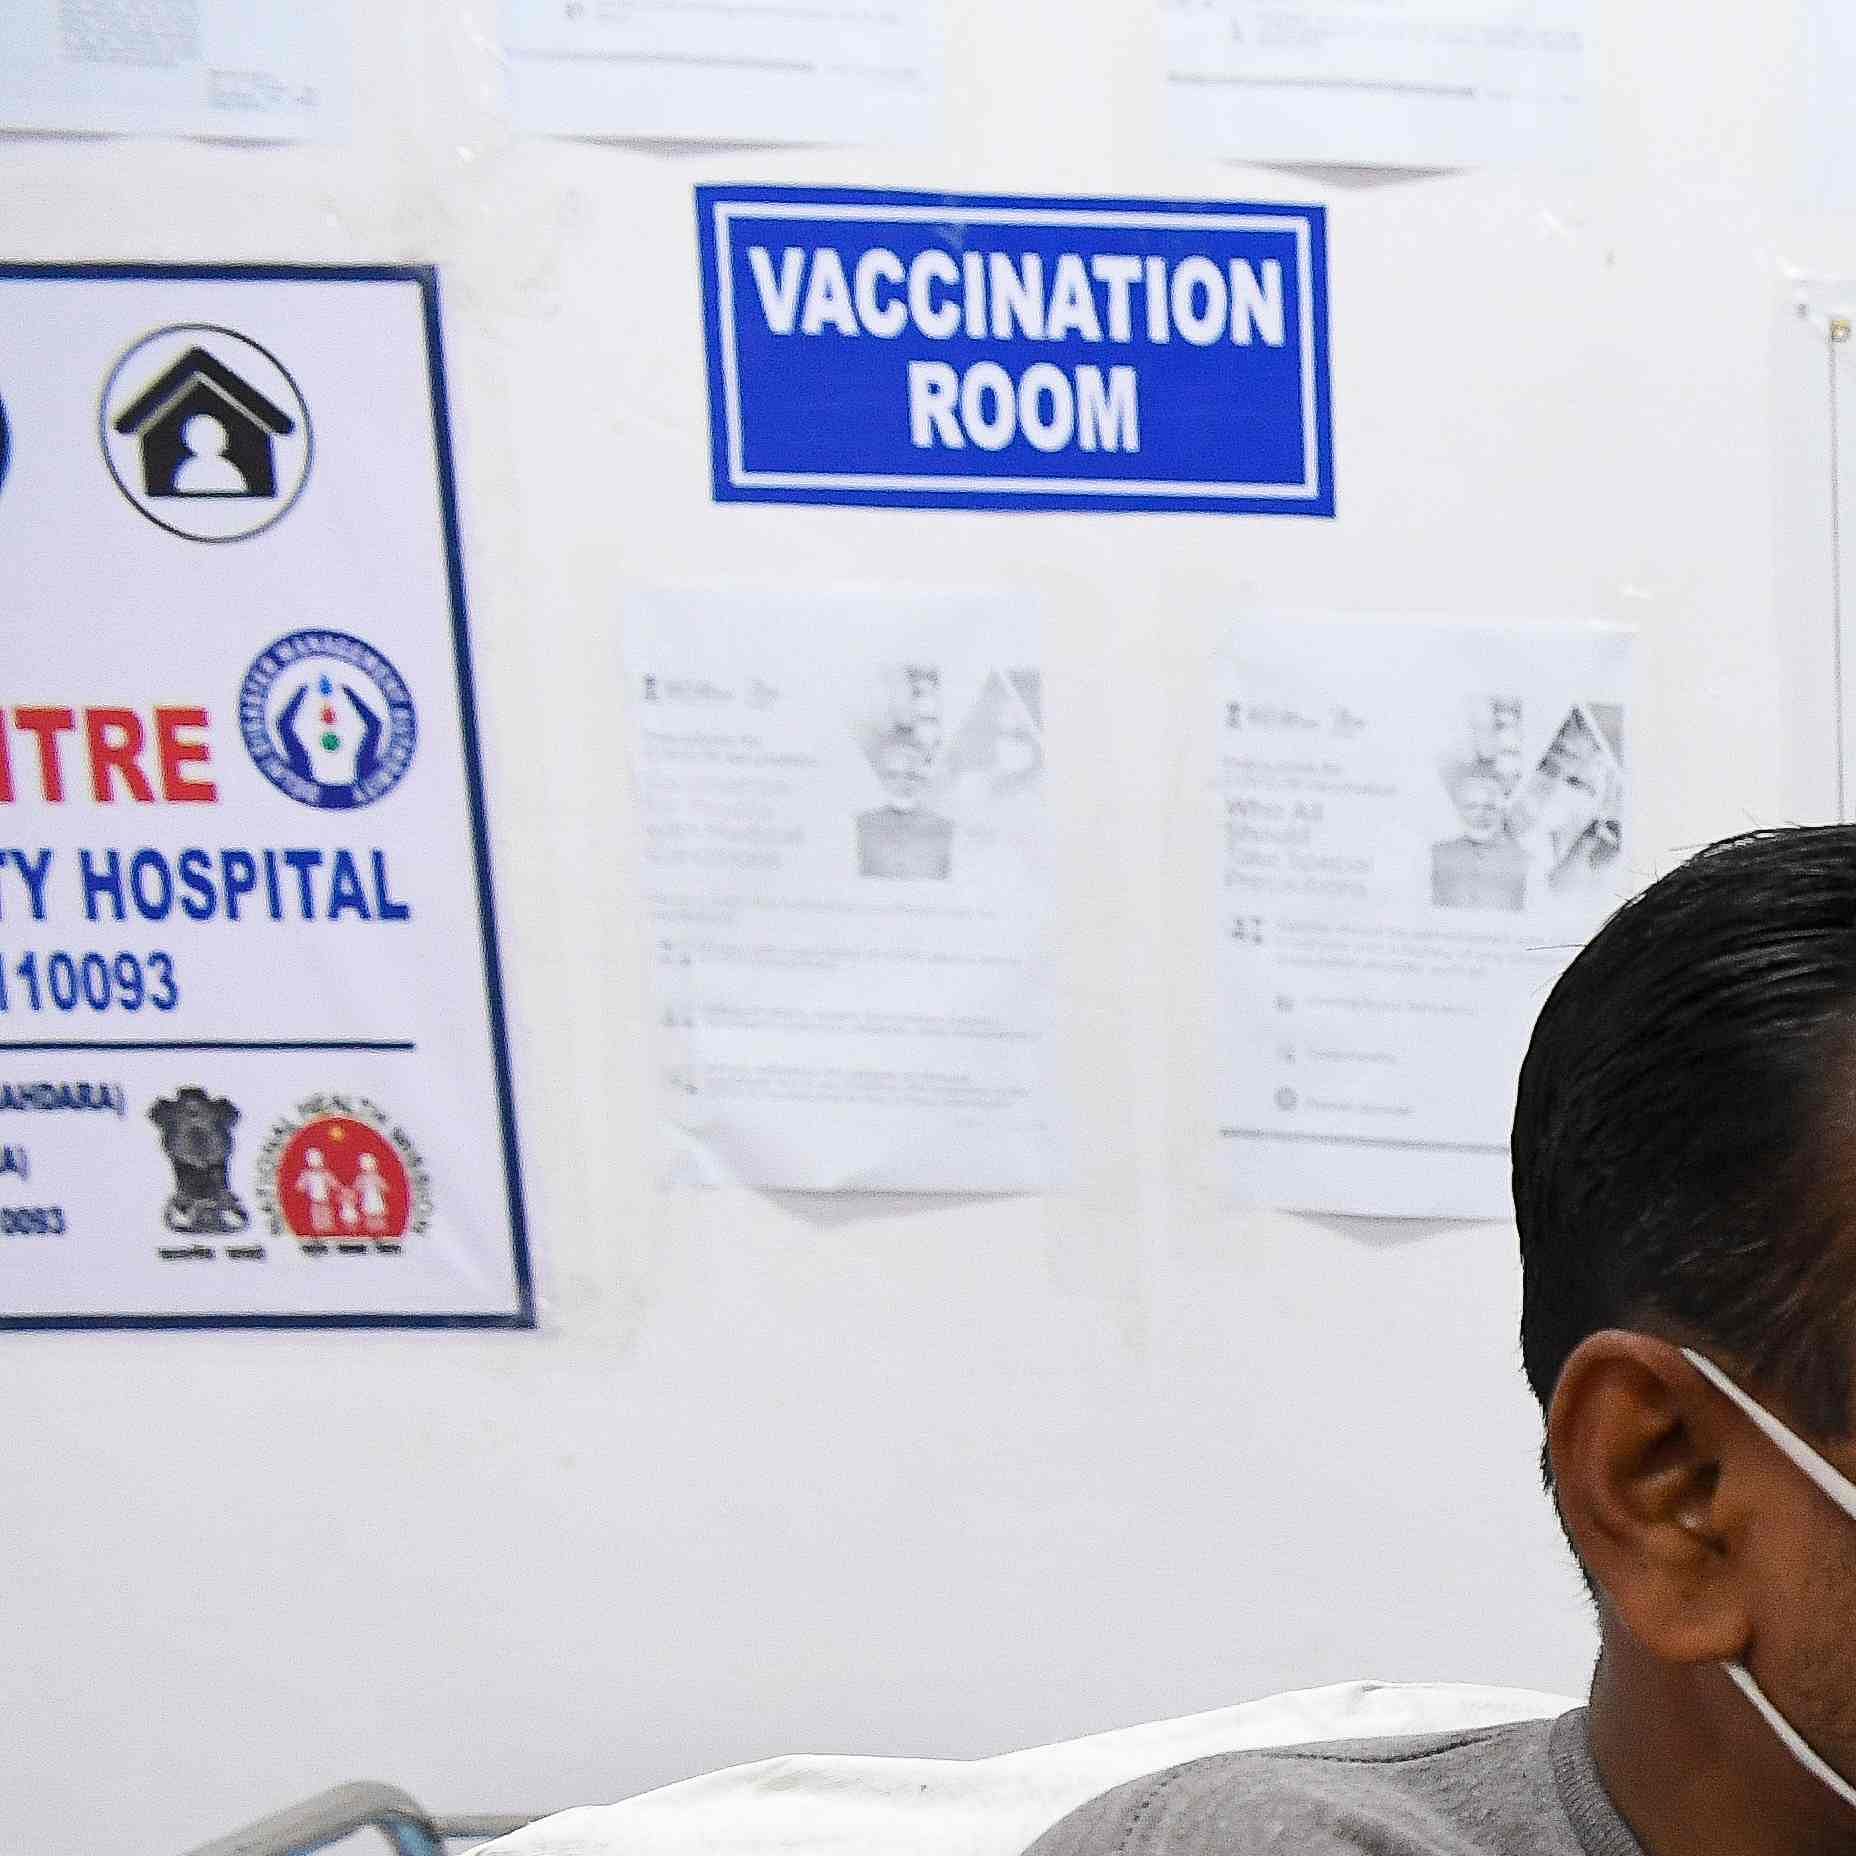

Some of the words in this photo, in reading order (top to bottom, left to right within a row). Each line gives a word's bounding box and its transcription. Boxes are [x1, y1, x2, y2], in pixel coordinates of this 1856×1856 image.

[747, 246, 1286, 347] VACCINATION
[907, 360, 1140, 453] ROOM
[78, 846, 411, 924] HOSPITAL
